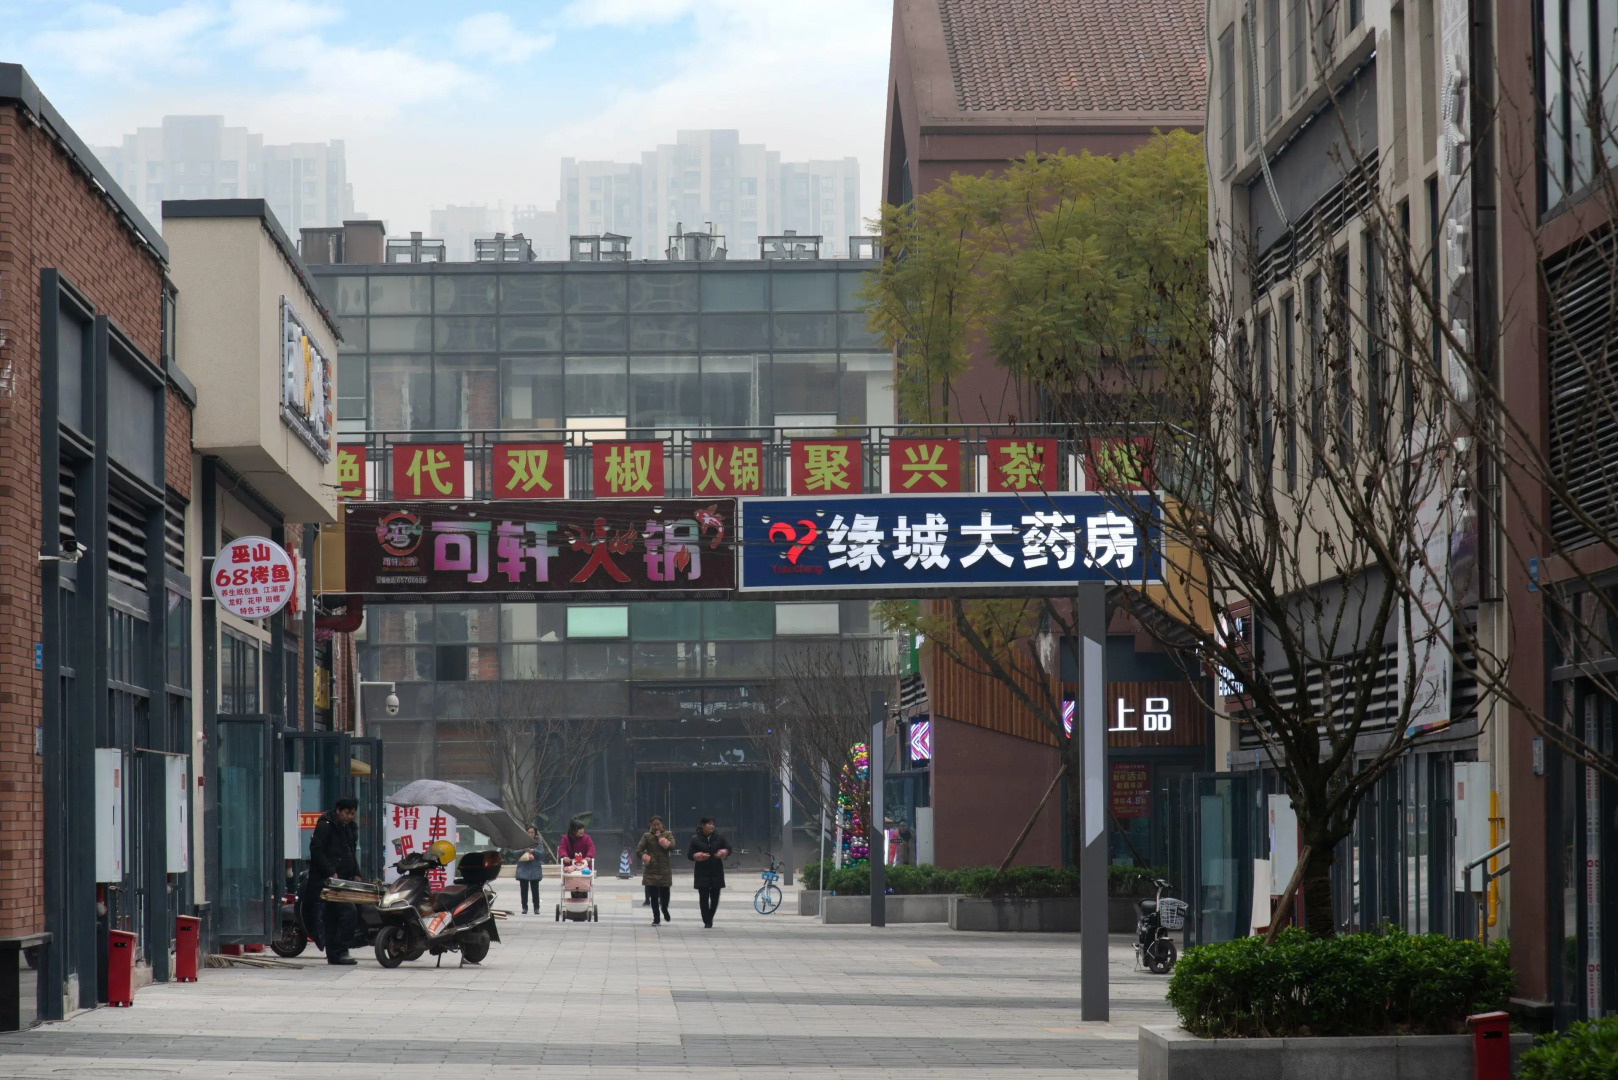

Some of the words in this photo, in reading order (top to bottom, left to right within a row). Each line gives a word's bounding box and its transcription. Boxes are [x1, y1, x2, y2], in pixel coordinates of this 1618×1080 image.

[431, 517, 702, 583] 可轩火锅
[826, 511, 1138, 571] 缘城大药房
[231, 542, 271, 564] 巫山
[215, 564, 290, 587] 68烤鱼
[221, 587, 259, 597] 养生纸包鱼
[263, 584, 286, 594] 江湖菜
[228, 597, 243, 606] 龙虾
[247, 596, 262, 605] 花甲
[239, 605, 271, 615] 特色干锅
[1108, 697, 1172, 732] 上品
